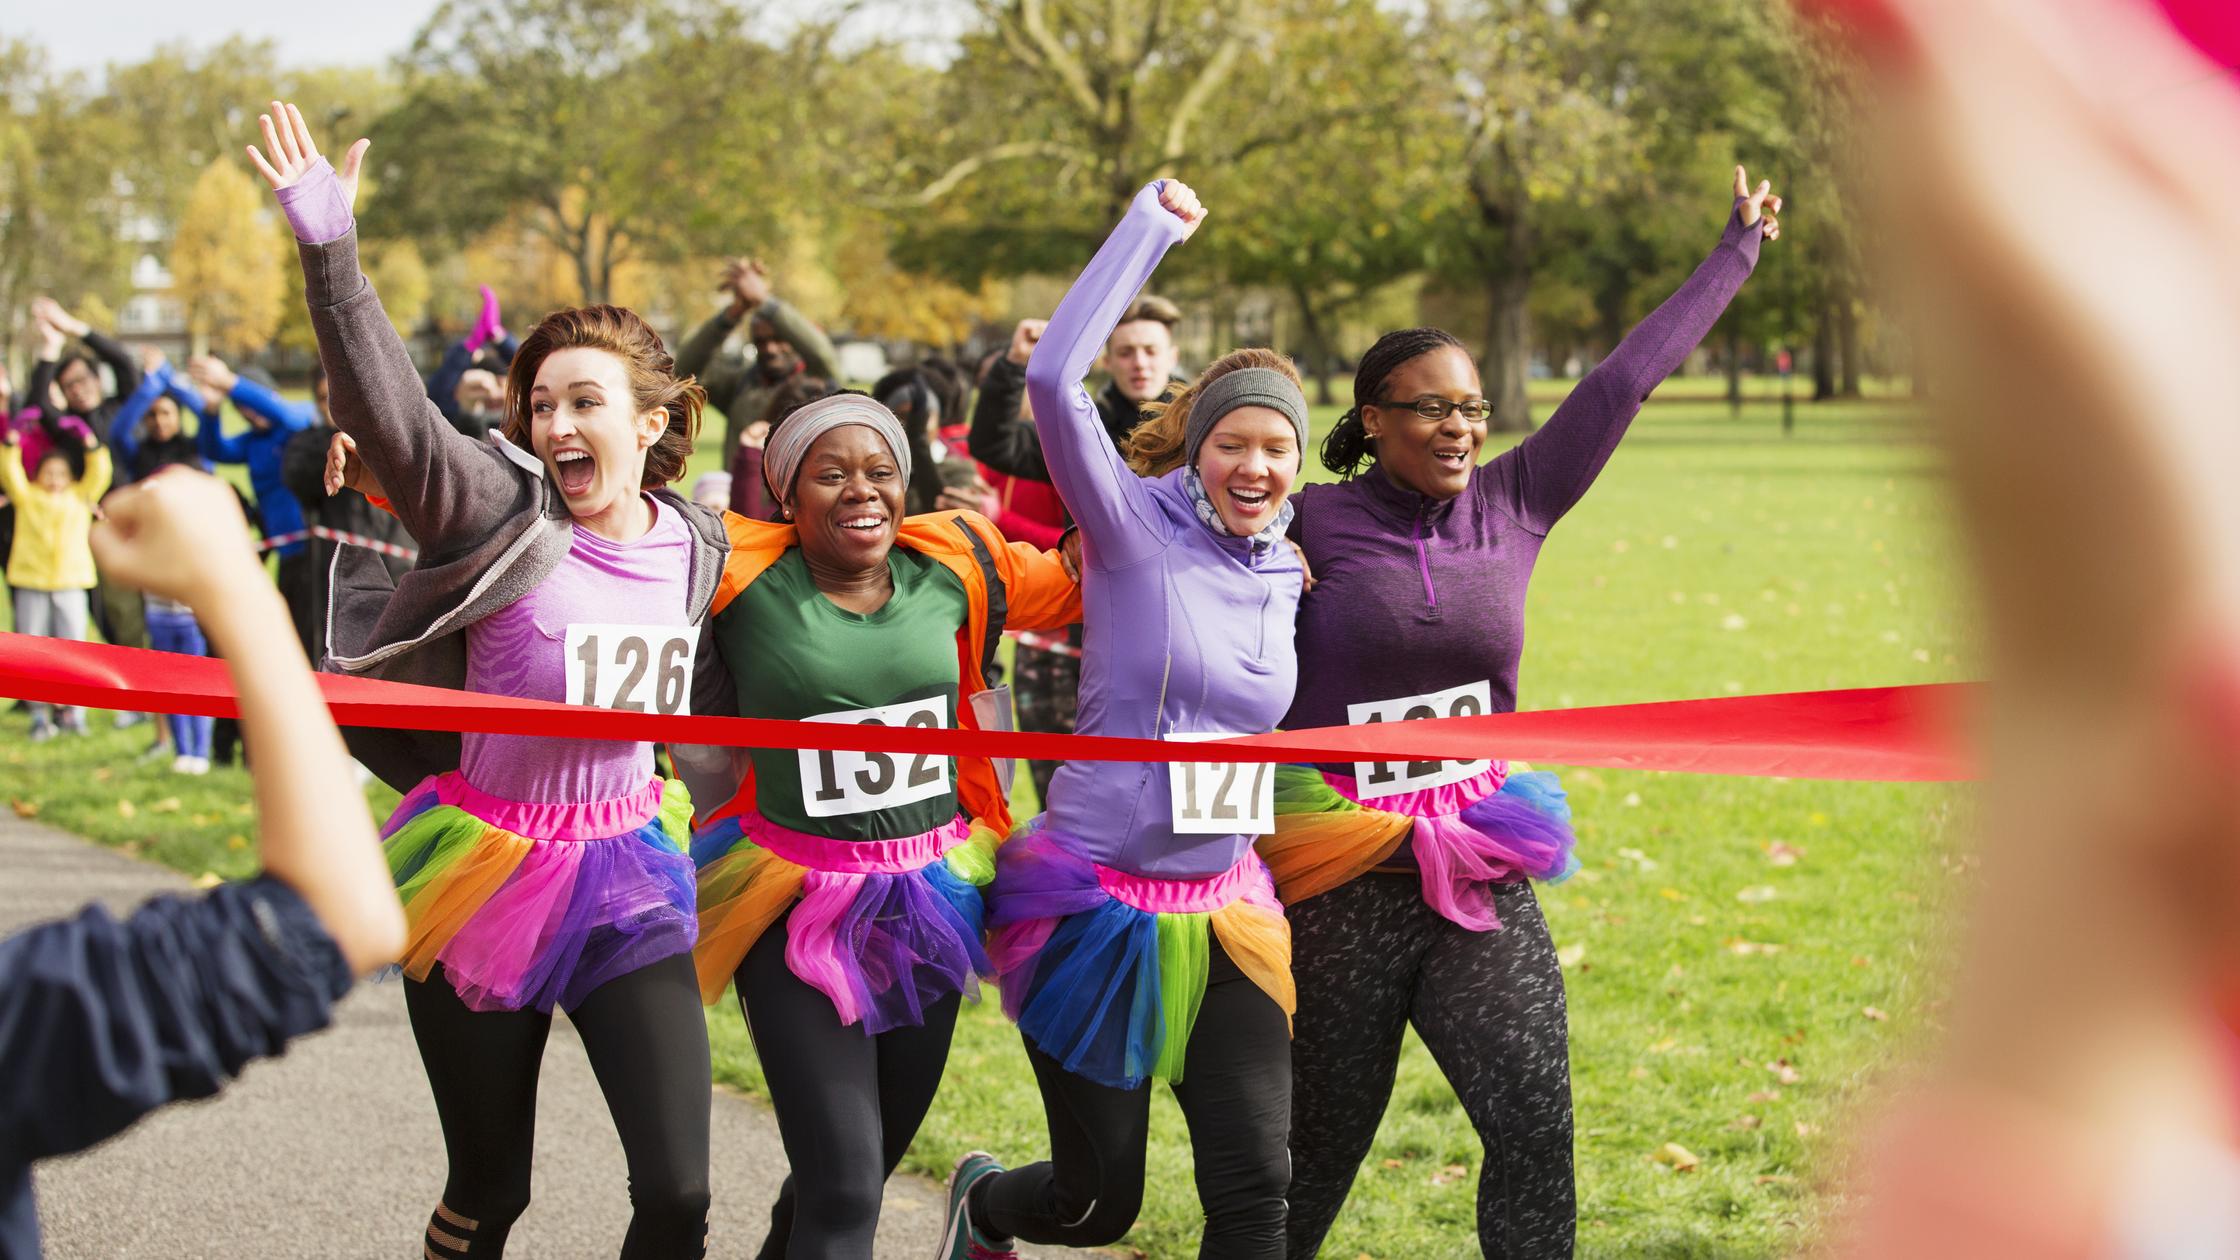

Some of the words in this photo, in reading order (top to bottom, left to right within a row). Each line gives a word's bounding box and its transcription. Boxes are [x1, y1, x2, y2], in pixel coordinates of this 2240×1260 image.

[577, 635, 690, 716] 126
[815, 709, 941, 802] 132
[1179, 761, 1268, 820] 127
